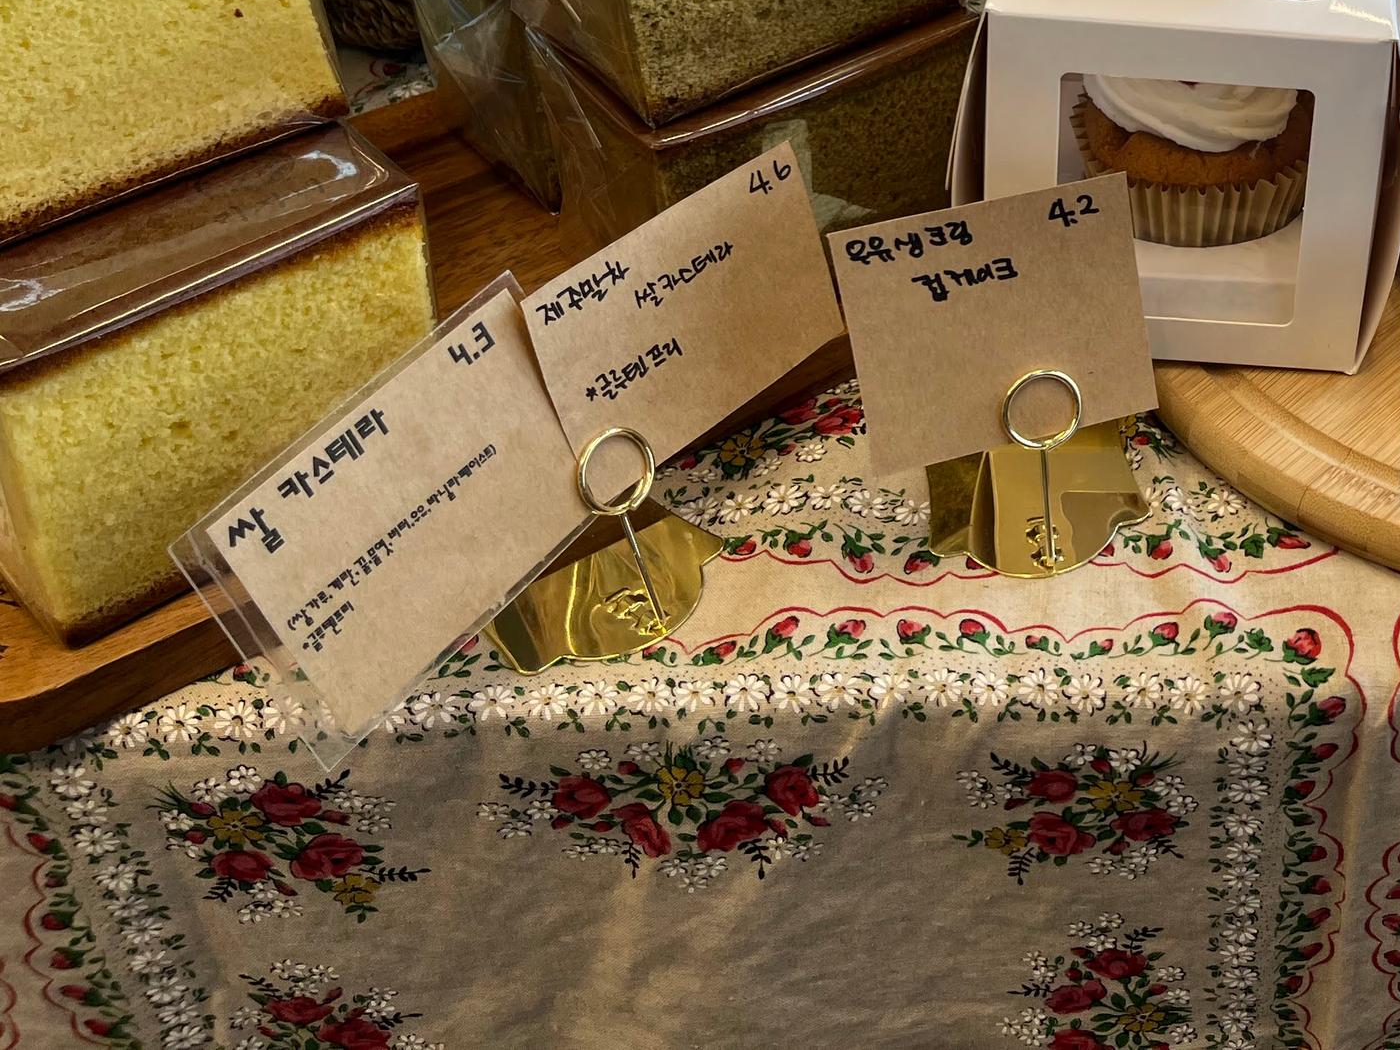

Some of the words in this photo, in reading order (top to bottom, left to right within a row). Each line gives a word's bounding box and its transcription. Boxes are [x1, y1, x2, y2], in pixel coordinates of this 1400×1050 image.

[749, 160, 792, 195] 4.6
[1048, 195, 1099, 227] 4.2
[447, 321, 496, 365] 4.3
[227, 506, 286, 554] 쌀
[276, 408, 391, 499] 카스테라
